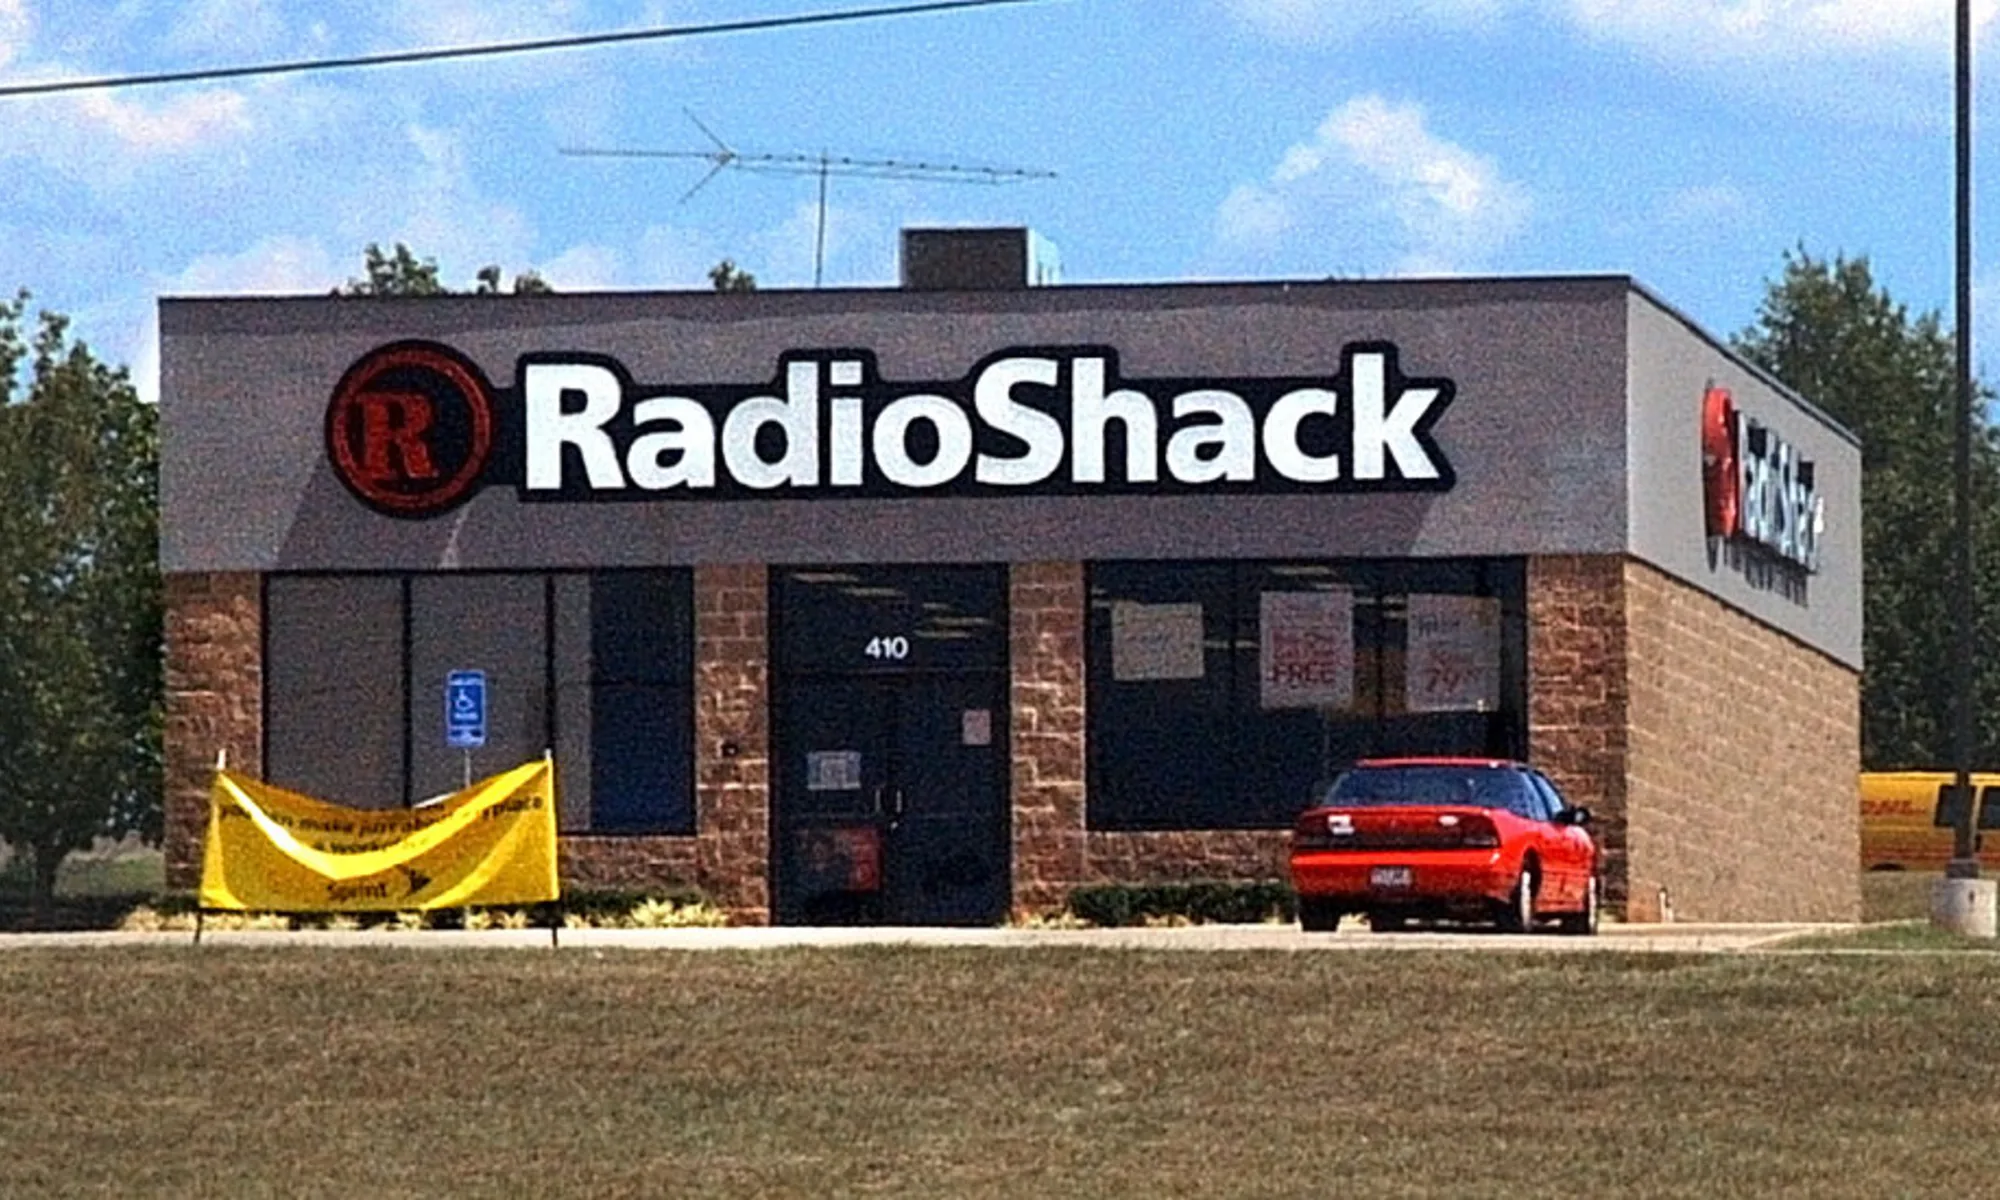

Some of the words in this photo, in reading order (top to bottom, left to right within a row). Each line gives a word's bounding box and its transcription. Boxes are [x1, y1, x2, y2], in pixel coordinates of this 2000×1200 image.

[526, 352, 1440, 490] RadioShack
[865, 636, 909, 659] 410
[326, 881, 388, 903] Sprint
